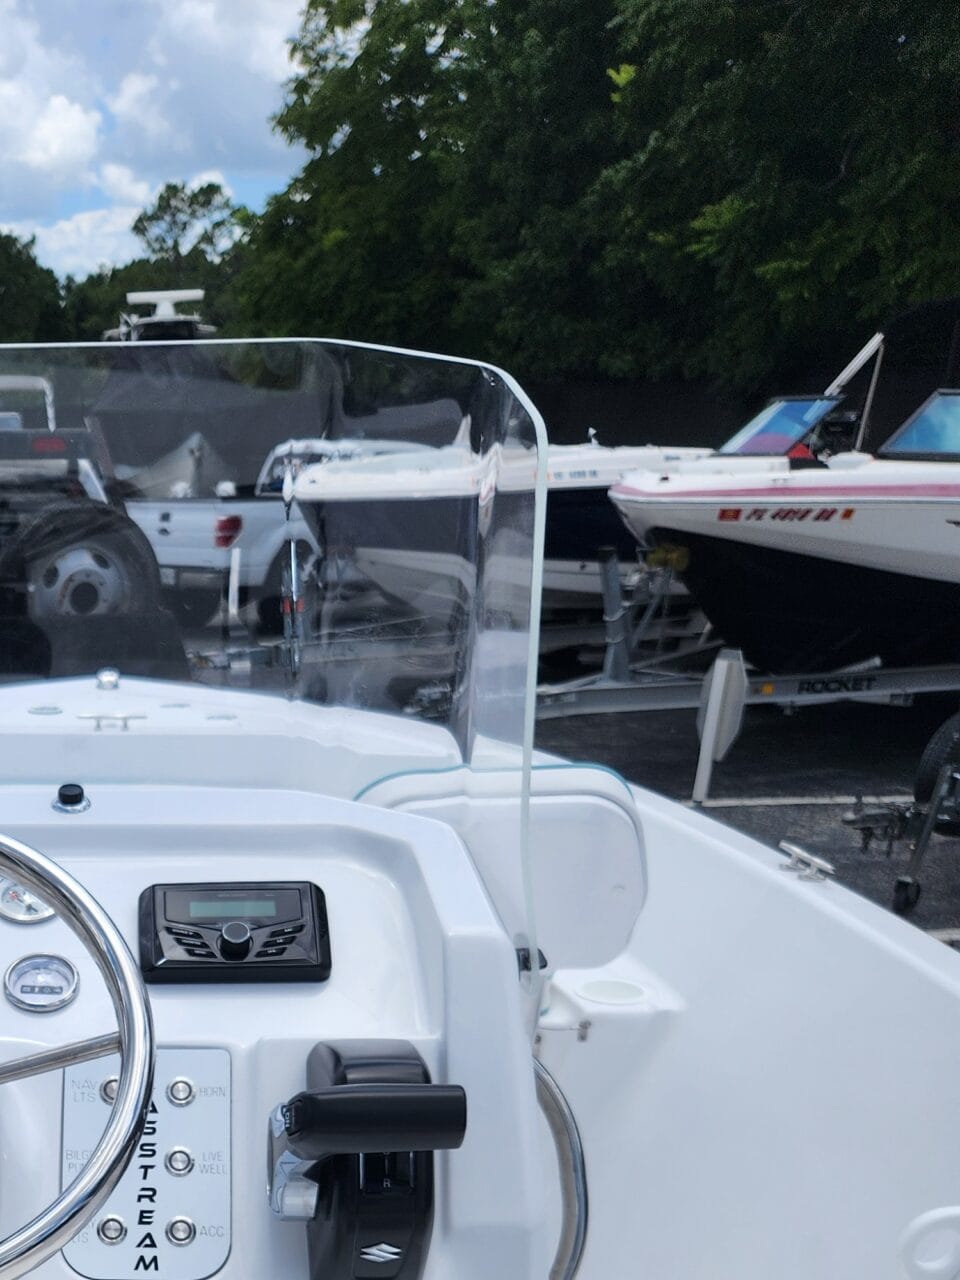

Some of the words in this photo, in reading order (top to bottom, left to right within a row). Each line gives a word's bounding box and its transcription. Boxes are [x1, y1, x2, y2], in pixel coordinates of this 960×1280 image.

[797, 675, 876, 695] ROCKET
[71, 1079, 98, 1090] NAV
[199, 1086, 226, 1097] HORN
[65, 1149, 91, 1161] BILG
[202, 1151, 224, 1162] LIVE
[200, 1164, 227, 1175] WELL
[134, 1101, 160, 1271] ASSTREAM
